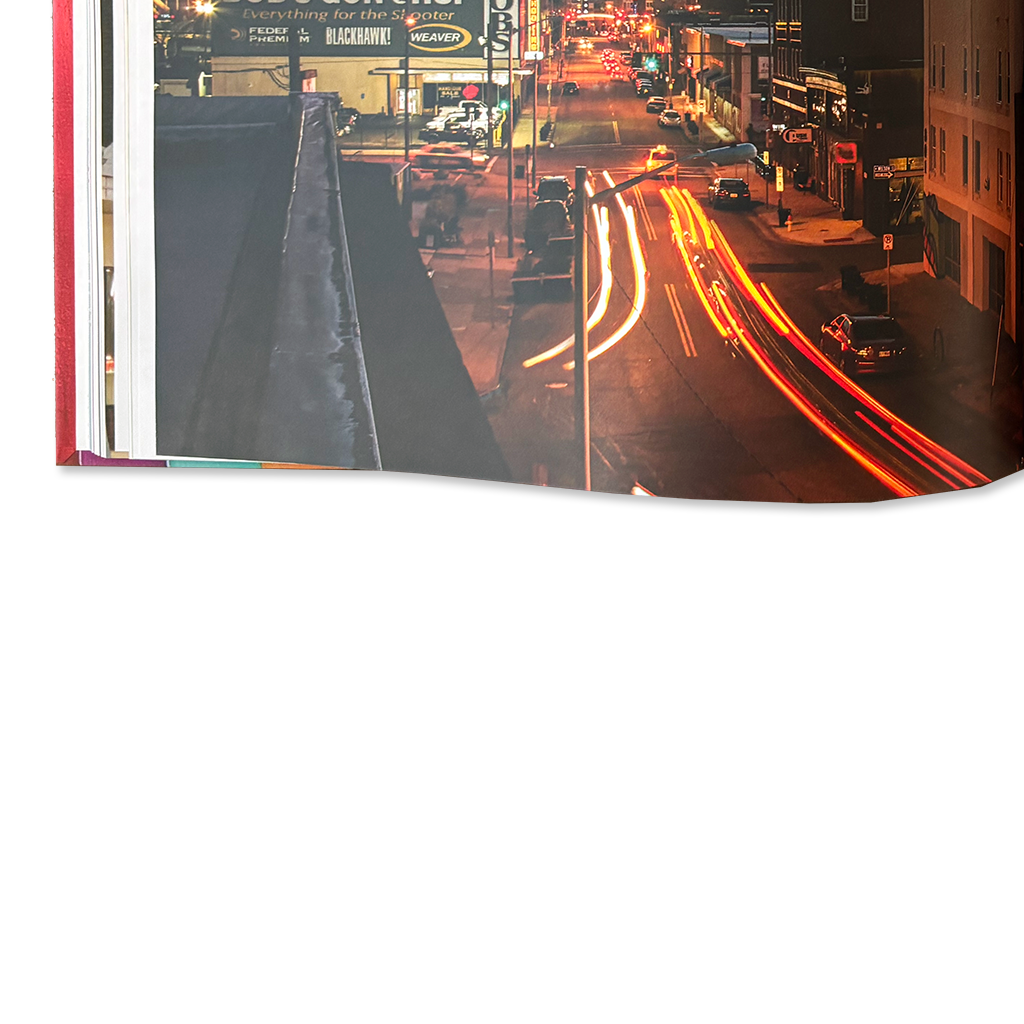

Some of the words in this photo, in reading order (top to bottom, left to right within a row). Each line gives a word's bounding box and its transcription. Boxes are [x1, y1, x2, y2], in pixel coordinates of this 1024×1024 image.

[243, 8, 328, 22] Everything
[333, 8, 356, 21] for
[359, 8, 387, 21] the
[249, 35, 310, 43] PREMIM
[325, 27, 392, 45] BLACKHAWK!
[410, 32, 461, 43] WEAVER
